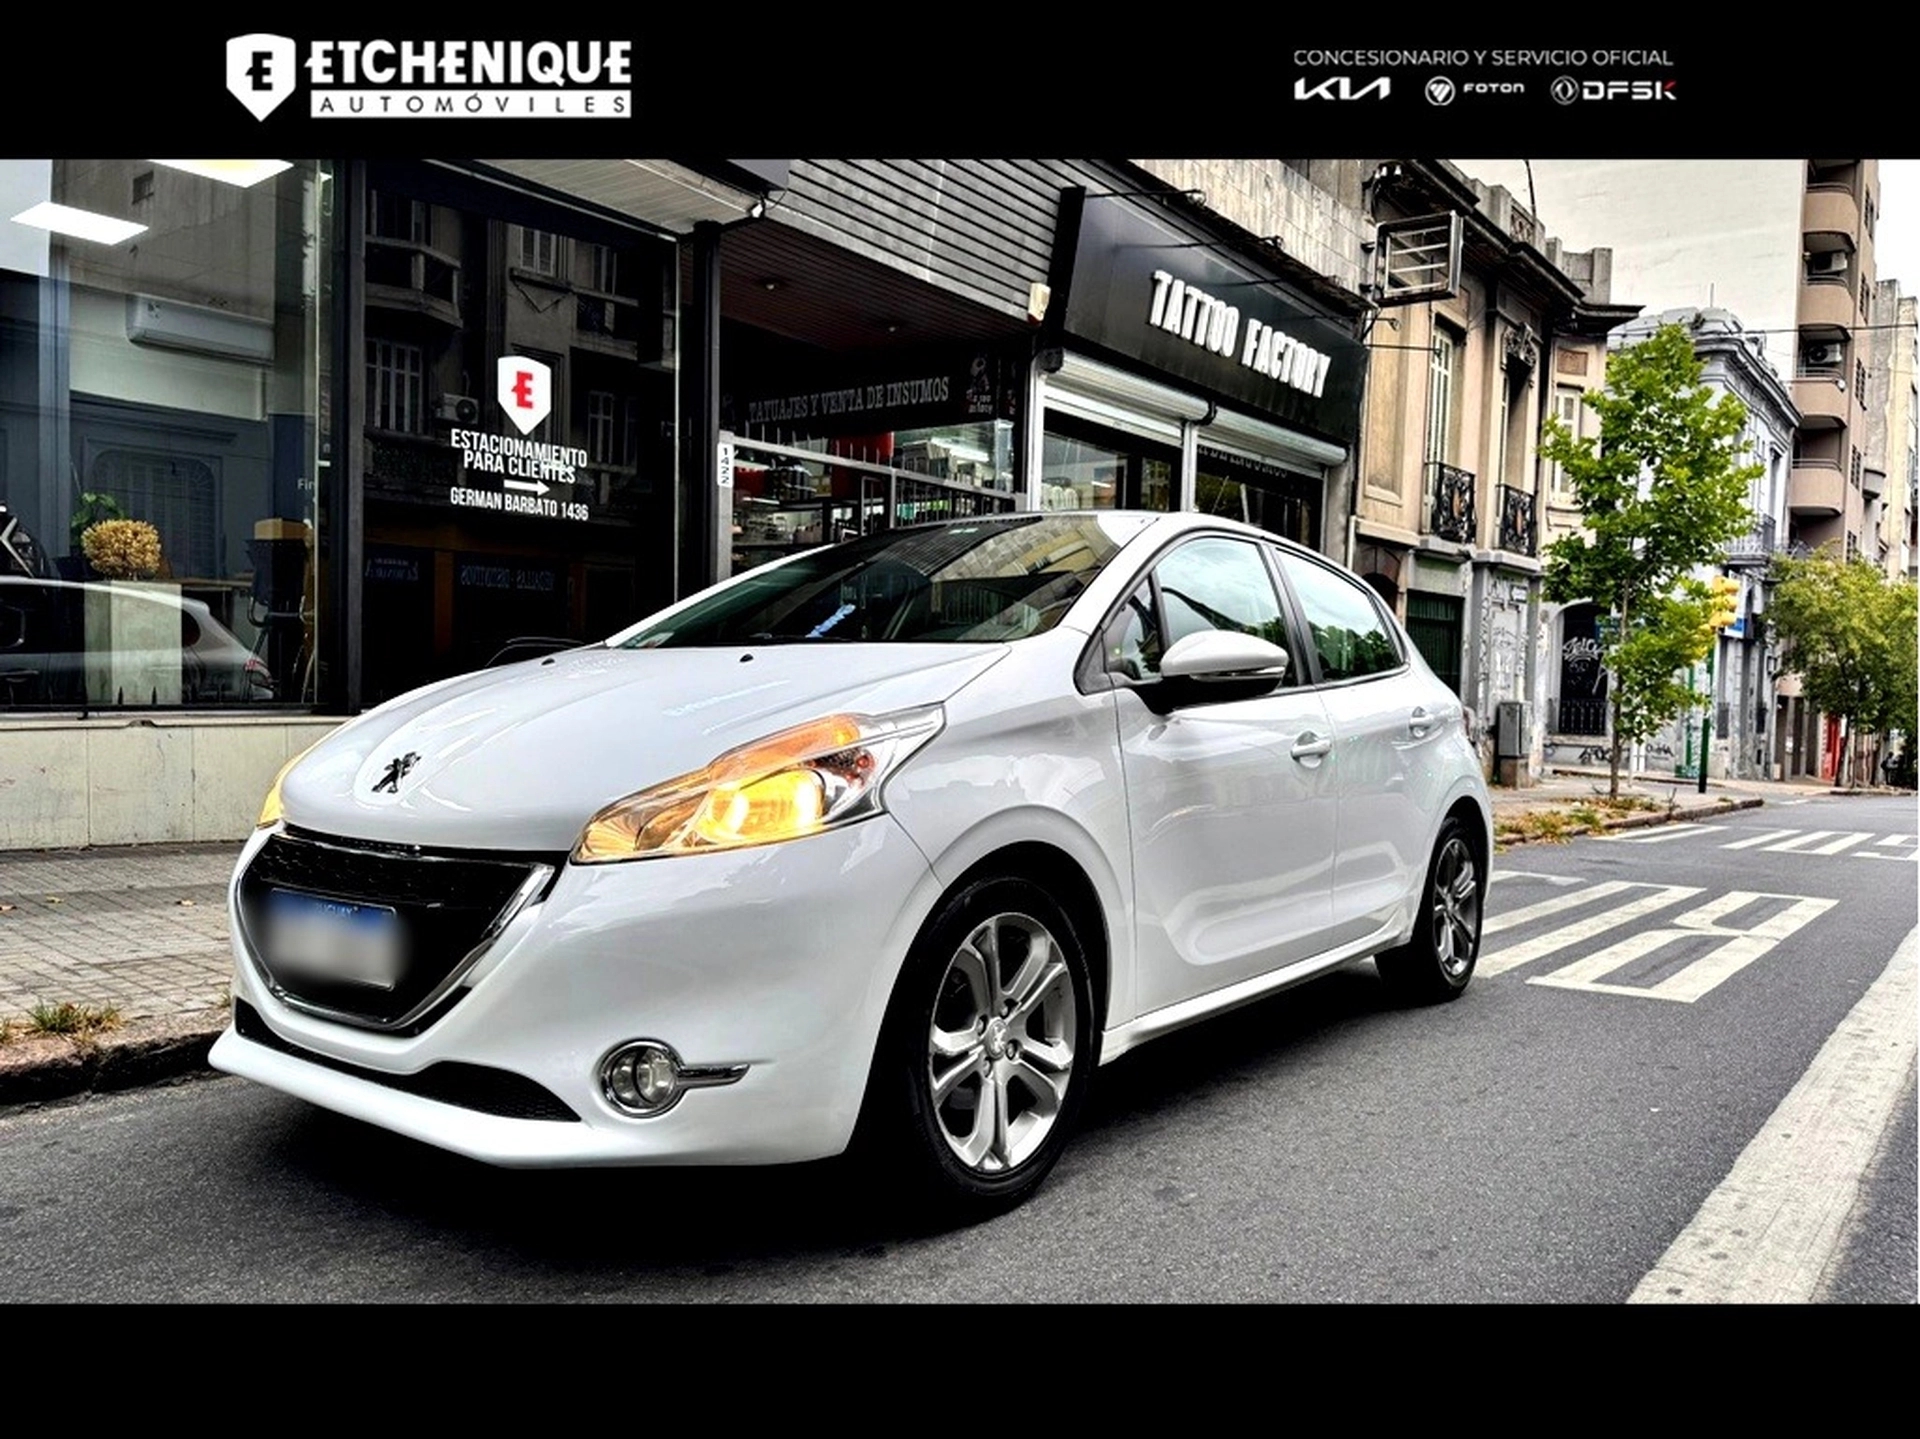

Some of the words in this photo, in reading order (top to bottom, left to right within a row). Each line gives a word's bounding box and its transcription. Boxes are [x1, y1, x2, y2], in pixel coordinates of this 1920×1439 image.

[1150, 270, 1240, 357] TATTOO
[1241, 318, 1331, 398] FACTORY
[749, 395, 808, 424] TATUAJES
[810, 393, 819, 416] Y
[821, 388, 864, 414] VENTA
[866, 384, 884, 409] DE
[886, 376, 950, 407] INSUMOS
[451, 428, 588, 468] ESTACIONAMIENTO
[464, 450, 504, 474] PARA
[508, 457, 576, 484] CLIENTES
[720, 447, 729, 484] 1422
[450, 487, 502, 510] GERMAN
[505, 494, 558, 517] BARBATO
[561, 502, 589, 521] 1436
